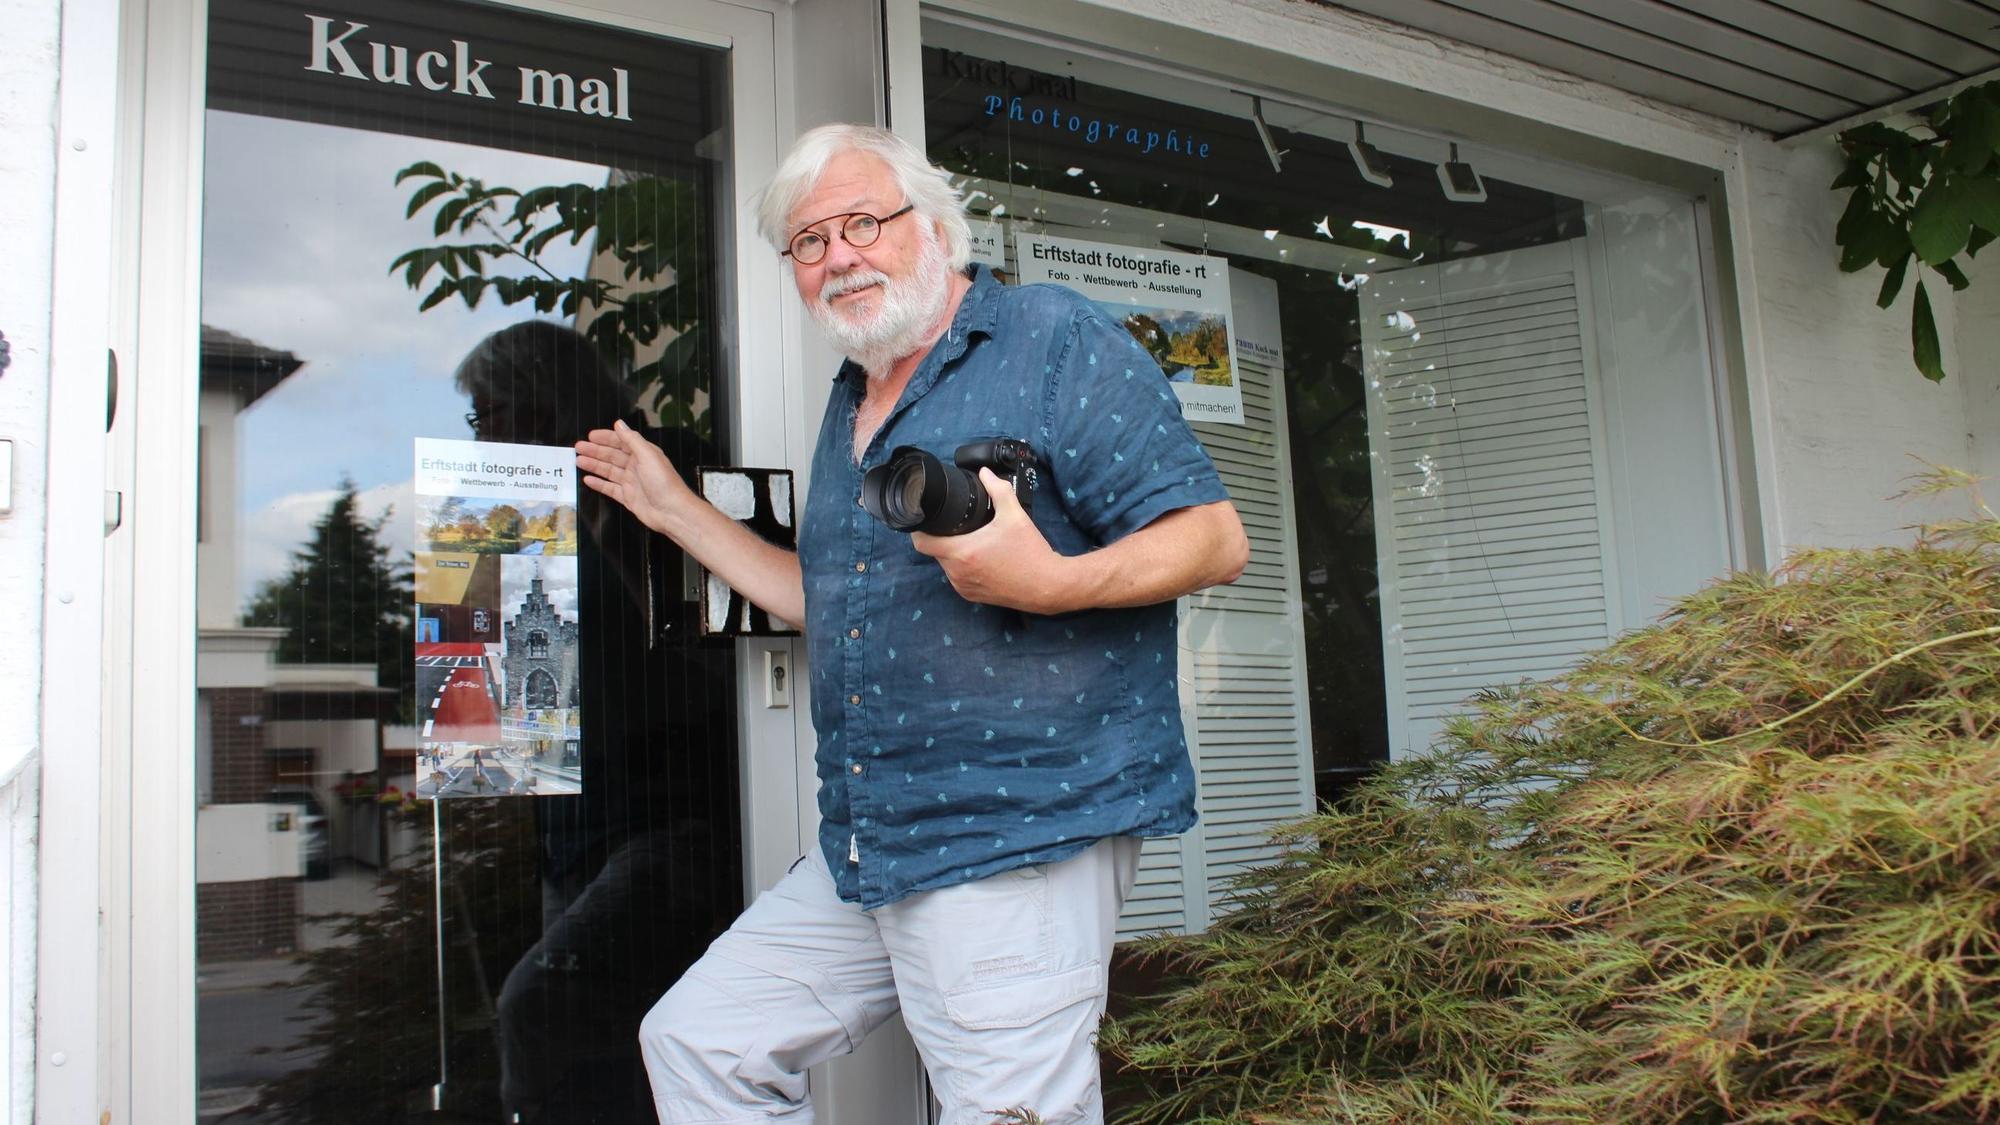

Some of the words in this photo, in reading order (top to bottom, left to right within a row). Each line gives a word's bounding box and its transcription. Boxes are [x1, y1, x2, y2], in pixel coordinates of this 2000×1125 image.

[304, 14, 495, 100] Kuck
[518, 66, 633, 122] mal
[940, 48, 1016, 88] Kuck
[1029, 75, 1077, 101] mal
[985, 94, 1209, 158] Photographie
[1032, 243, 1103, 267] Erftstadt
[1106, 252, 1181, 276] fotografie
[1195, 265, 1207, 279] rt
[1048, 269, 1070, 281] Foto
[1083, 273, 1138, 289] Wettbewerb
[1148, 281, 1202, 298] Ausstellung
[1186, 402, 1237, 415] mitmachen!
[421, 457, 477, 473] Erftstadt
[481, 461, 542, 477] fotografie
[554, 467, 563, 477] rt
[460, 478, 505, 488] Wettbewerb
[513, 481, 558, 491] Ausstellung
